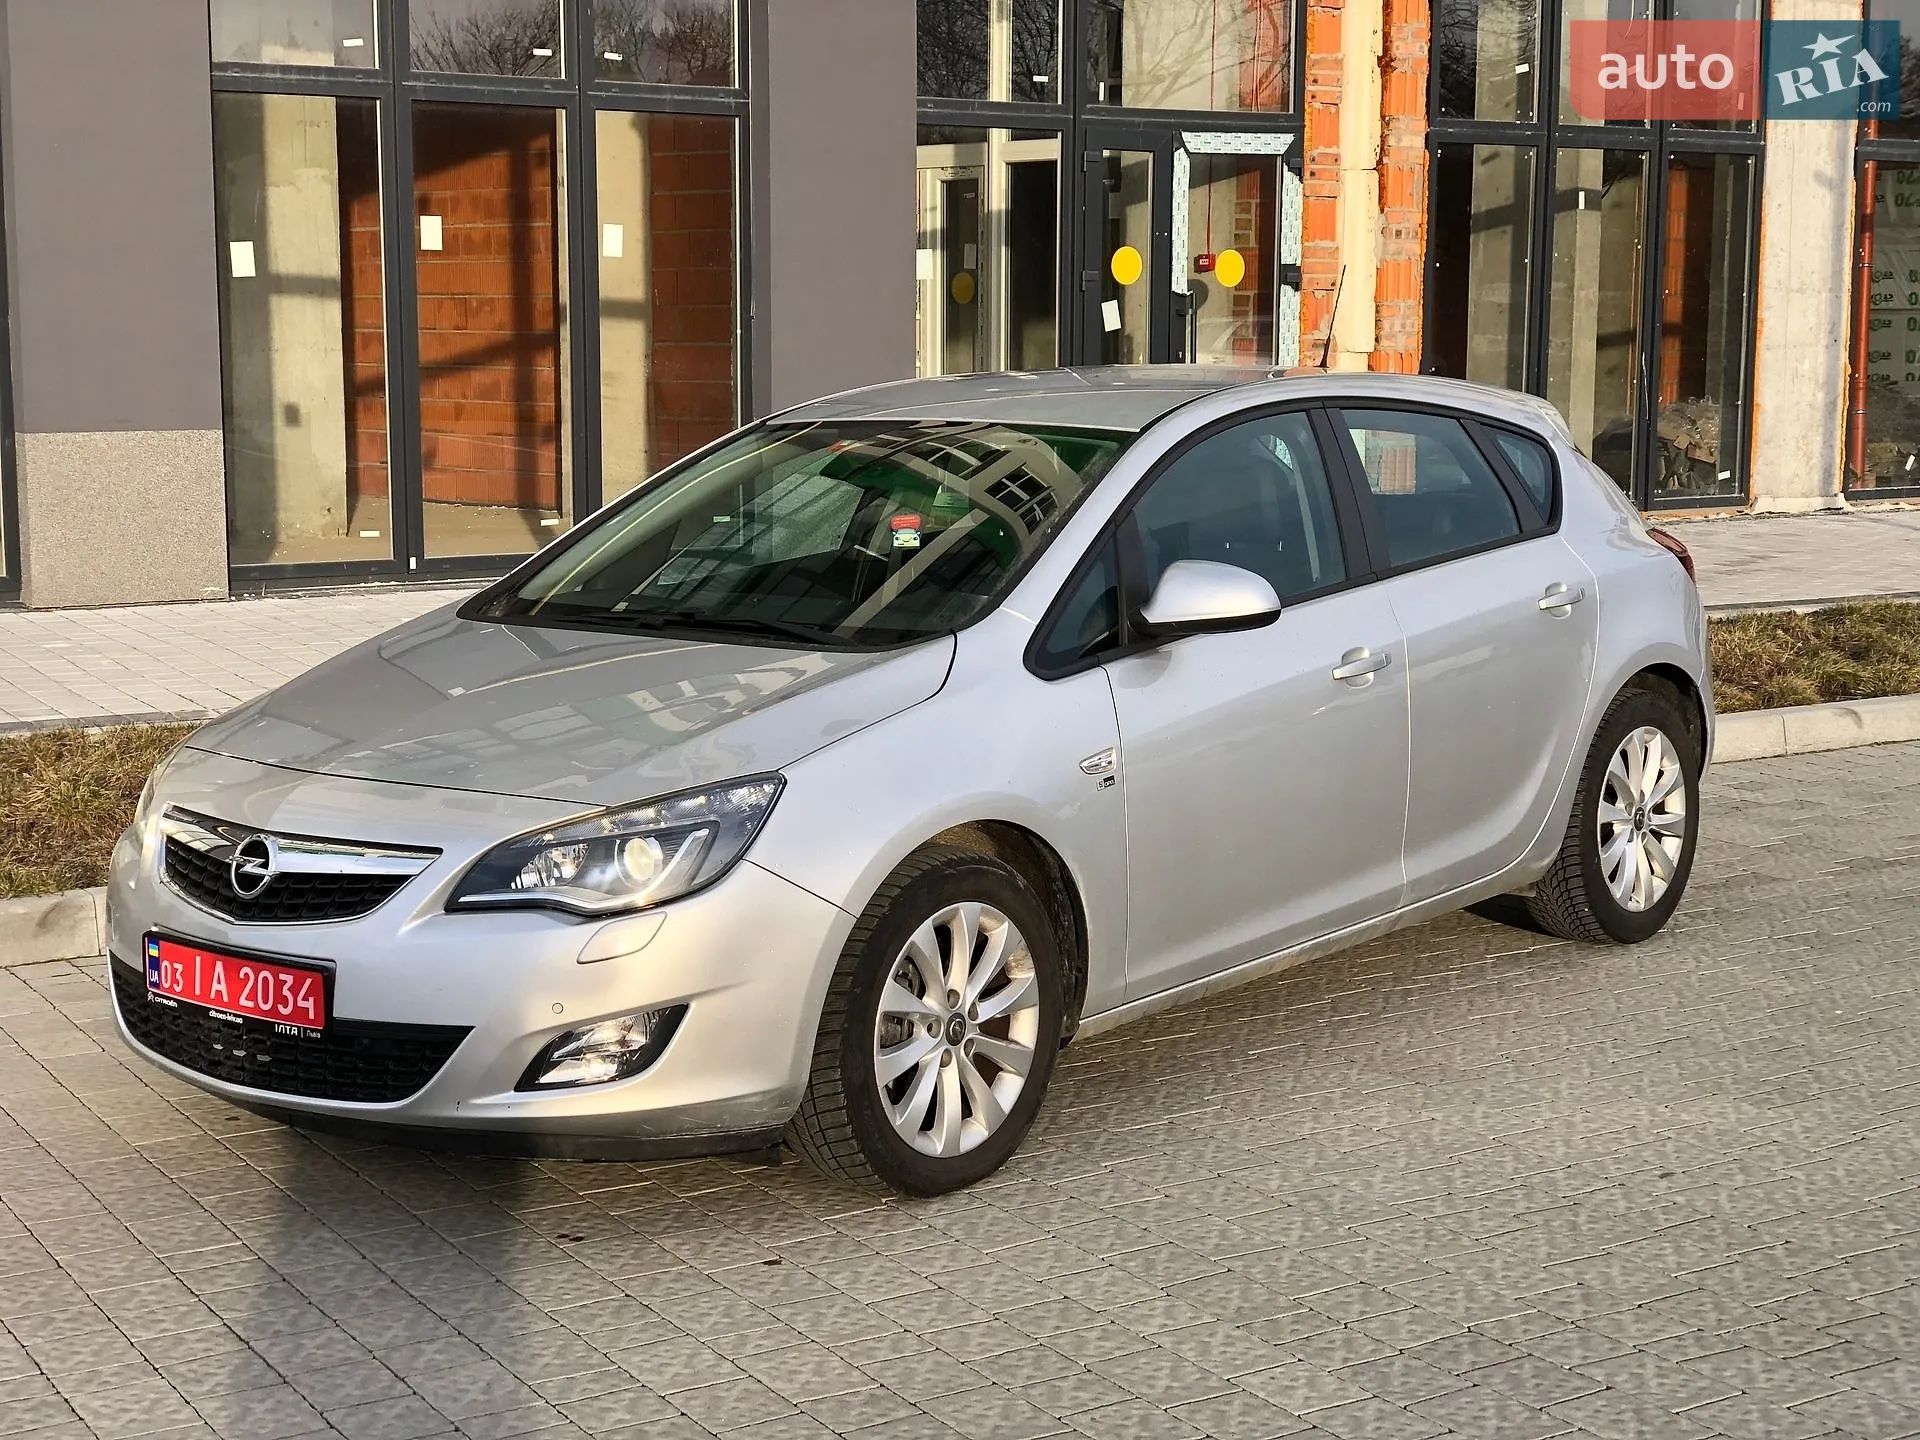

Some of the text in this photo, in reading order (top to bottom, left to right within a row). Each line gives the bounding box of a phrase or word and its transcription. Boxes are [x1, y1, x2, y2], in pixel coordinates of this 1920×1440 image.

[149, 968, 159, 984] UA
[161, 959, 184, 993] 03
[239, 966, 315, 1020] 2034
